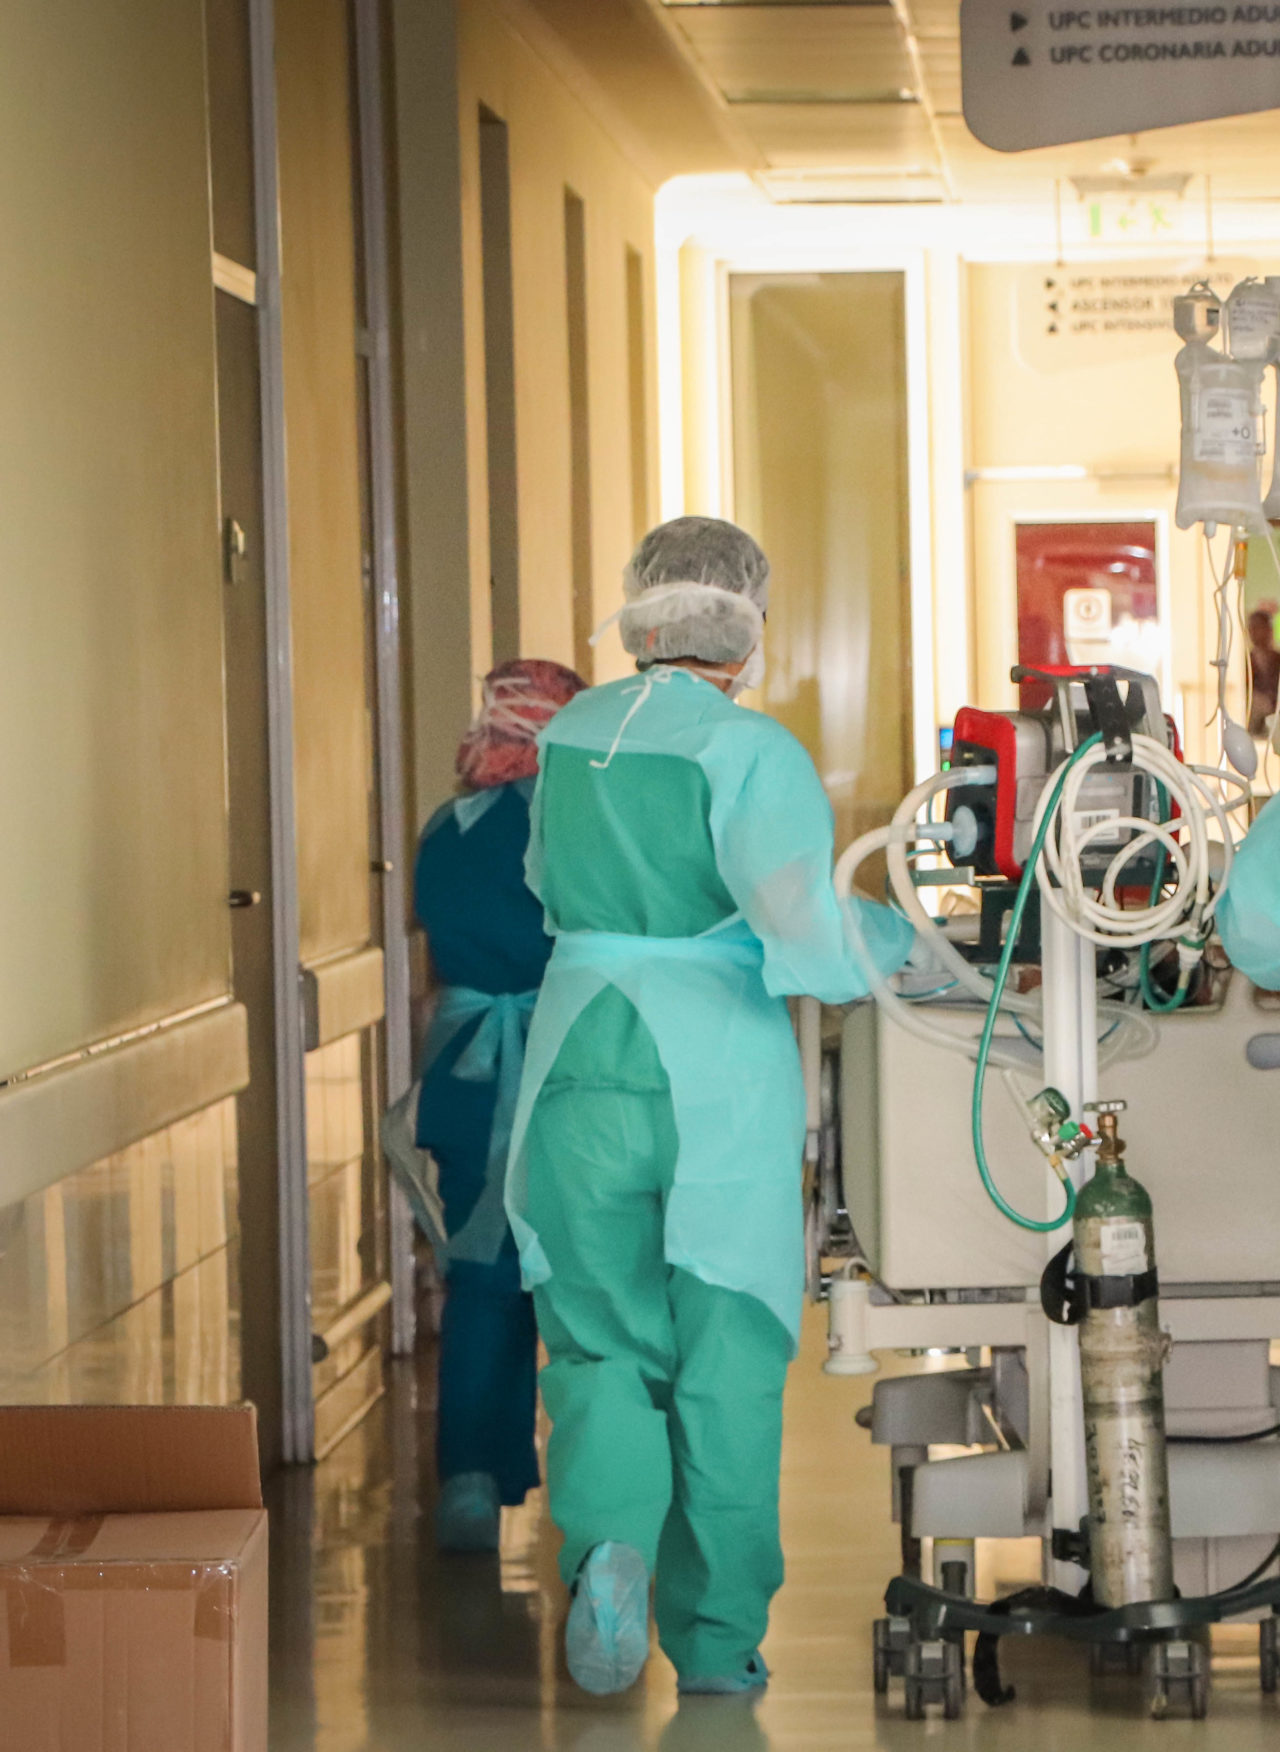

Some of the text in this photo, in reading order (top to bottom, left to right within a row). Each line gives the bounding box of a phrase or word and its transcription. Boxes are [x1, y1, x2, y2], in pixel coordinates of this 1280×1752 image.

[1049, 10, 1091, 30] UPC
[1098, 7, 1227, 27] INTERMEDIO
[1050, 45, 1092, 64] UPC
[1099, 41, 1226, 61] CORONARIA
